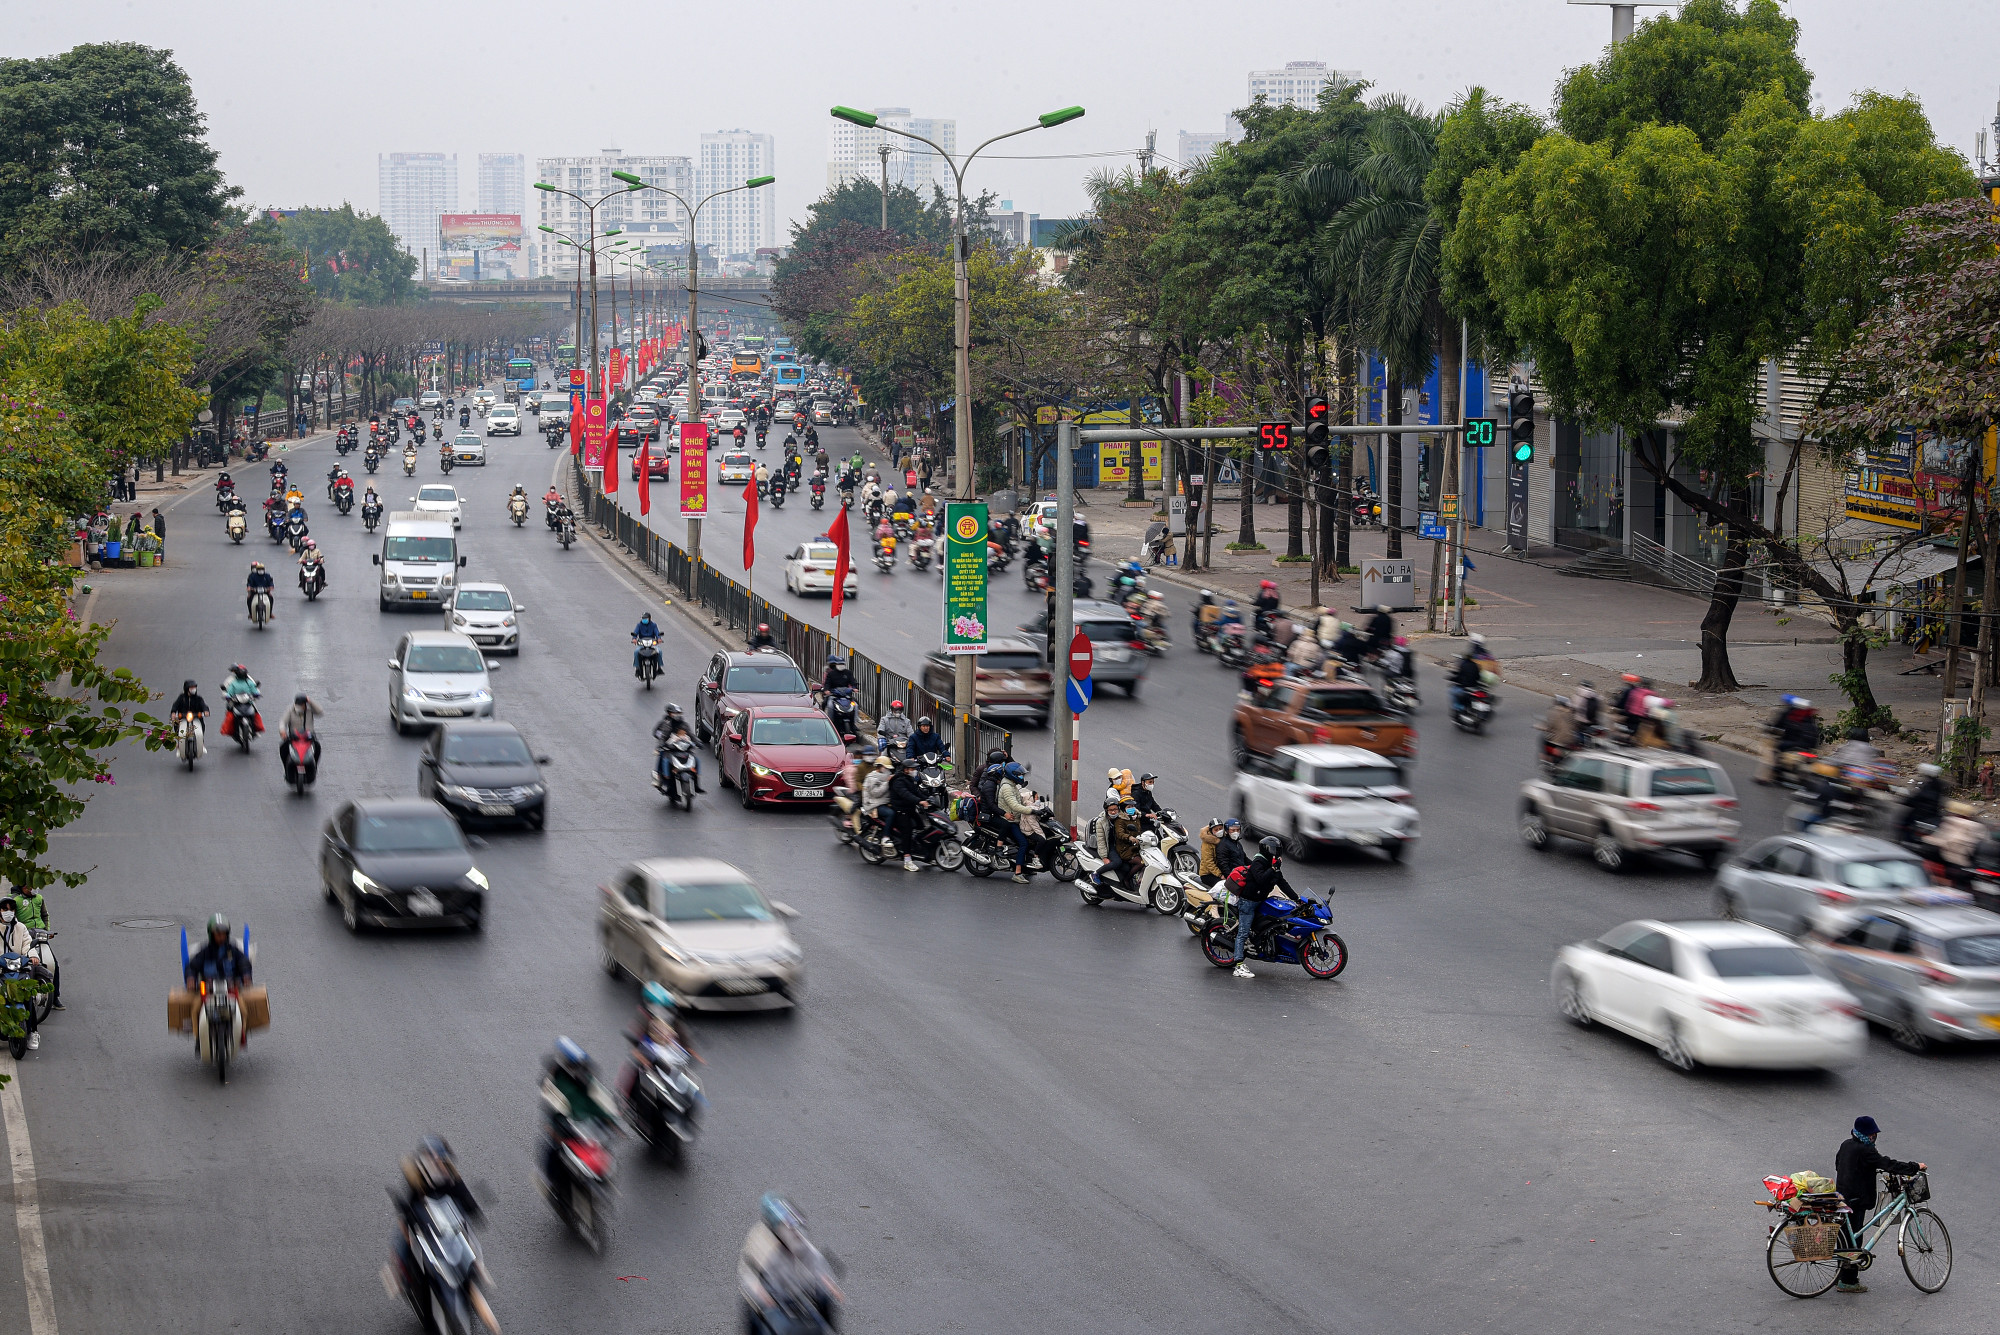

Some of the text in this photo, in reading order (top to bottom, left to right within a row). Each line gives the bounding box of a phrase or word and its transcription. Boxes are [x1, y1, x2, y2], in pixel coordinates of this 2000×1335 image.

[1261, 425, 1288, 448] 55
[1467, 422, 1492, 444] 20
[685, 437, 703, 446] CHÚC
[684, 448, 704, 456] MỪNG
[687, 459, 702, 468] NĂM
[688, 470, 700, 478] MỚI
[1400, 565, 1412, 574] RA
